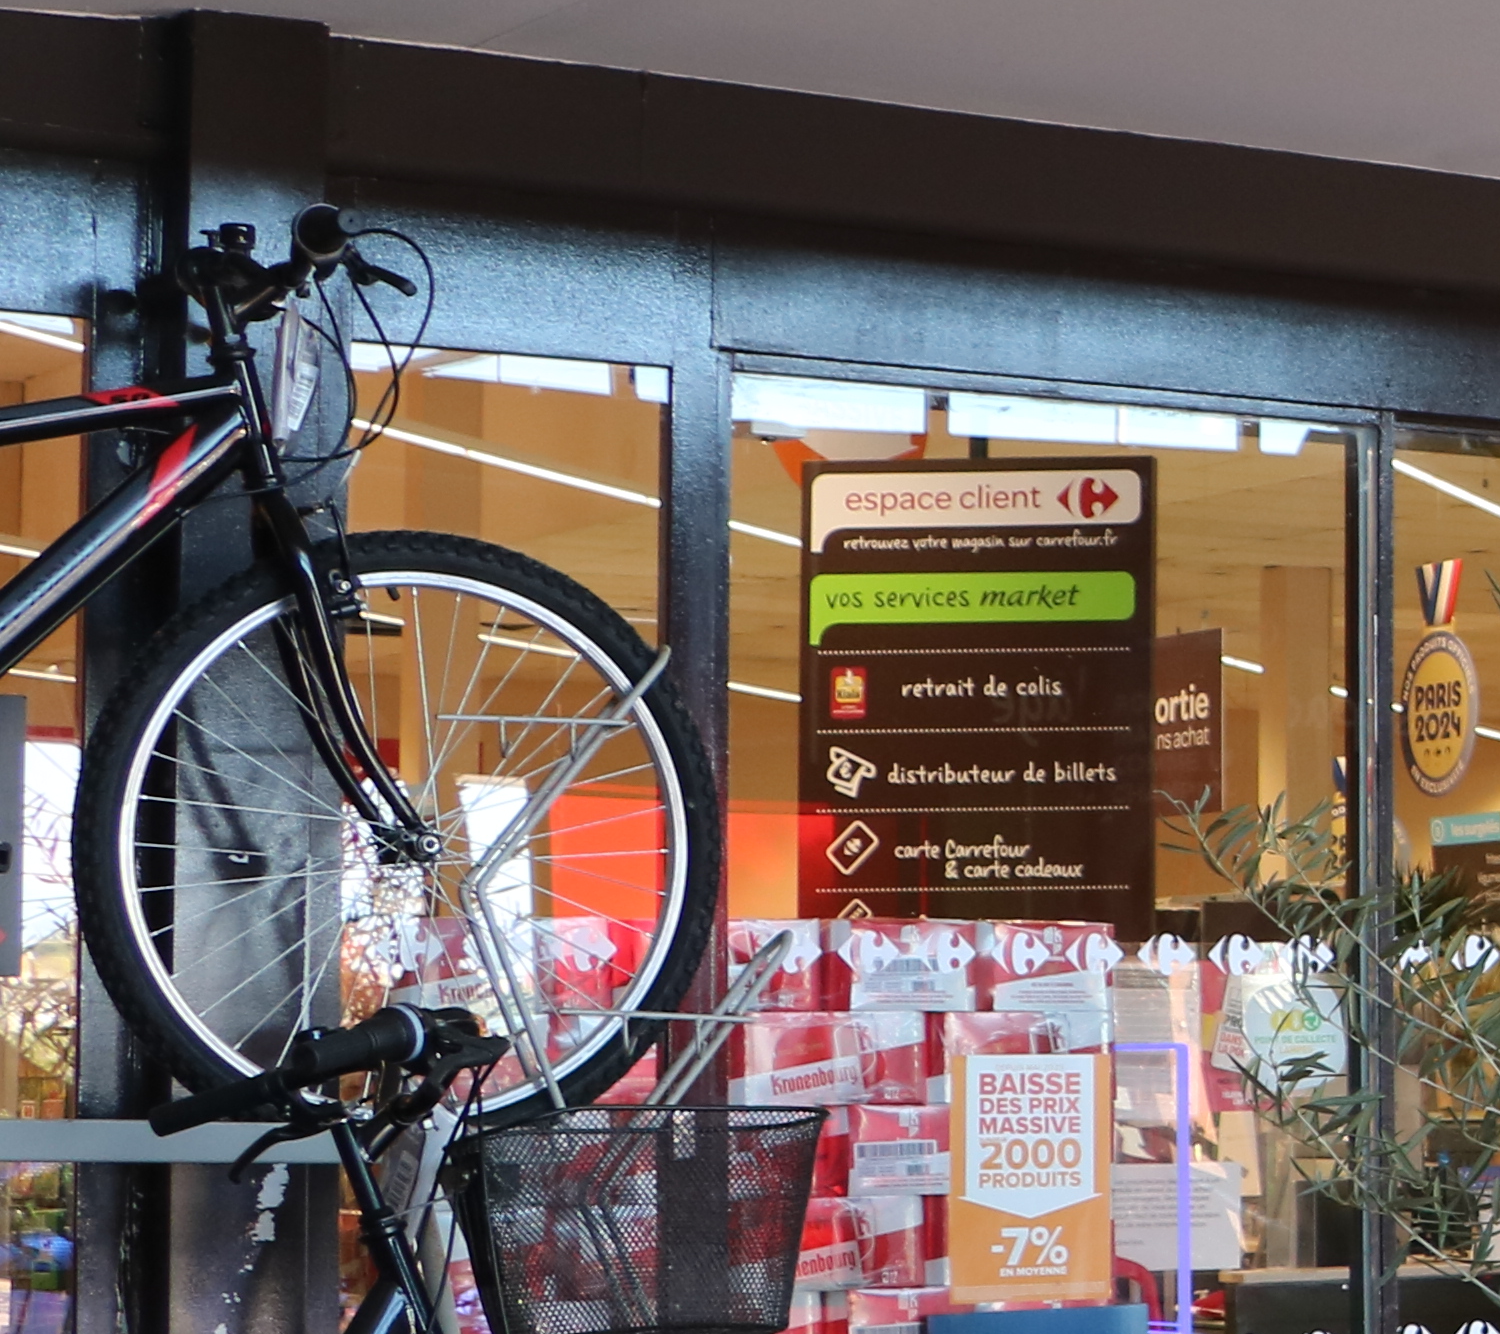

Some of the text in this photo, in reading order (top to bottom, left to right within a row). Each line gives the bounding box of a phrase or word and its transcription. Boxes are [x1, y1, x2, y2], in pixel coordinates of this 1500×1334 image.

[844, 484, 1041, 517] espace client
[843, 528, 1119, 554] retrouvez votre magasin sur carrefour.fr
[826, 583, 1081, 610] vos services market
[901, 673, 1063, 698] retrait de colis
[1415, 679, 1463, 713] PARIS
[1155, 684, 1211, 724] ortie
[1173, 726, 1211, 749] achat
[1415, 711, 1462, 743] 2024
[887, 762, 1118, 785] distributeur de billets
[894, 834, 1031, 860] carte Carrefour
[944, 857, 1084, 879] & carte cadeaux
[979, 1073, 1081, 1096] BAISSE
[979, 1097, 1080, 1115] DES PRIX
[978, 1116, 1081, 1134] MASSIVE
[979, 1138, 1082, 1170] 2000
[978, 1171, 1081, 1188] PRODUITS
[990, 1226, 1069, 1267] -7%
[1000, 1266, 1067, 1277] EN MOYENNE
